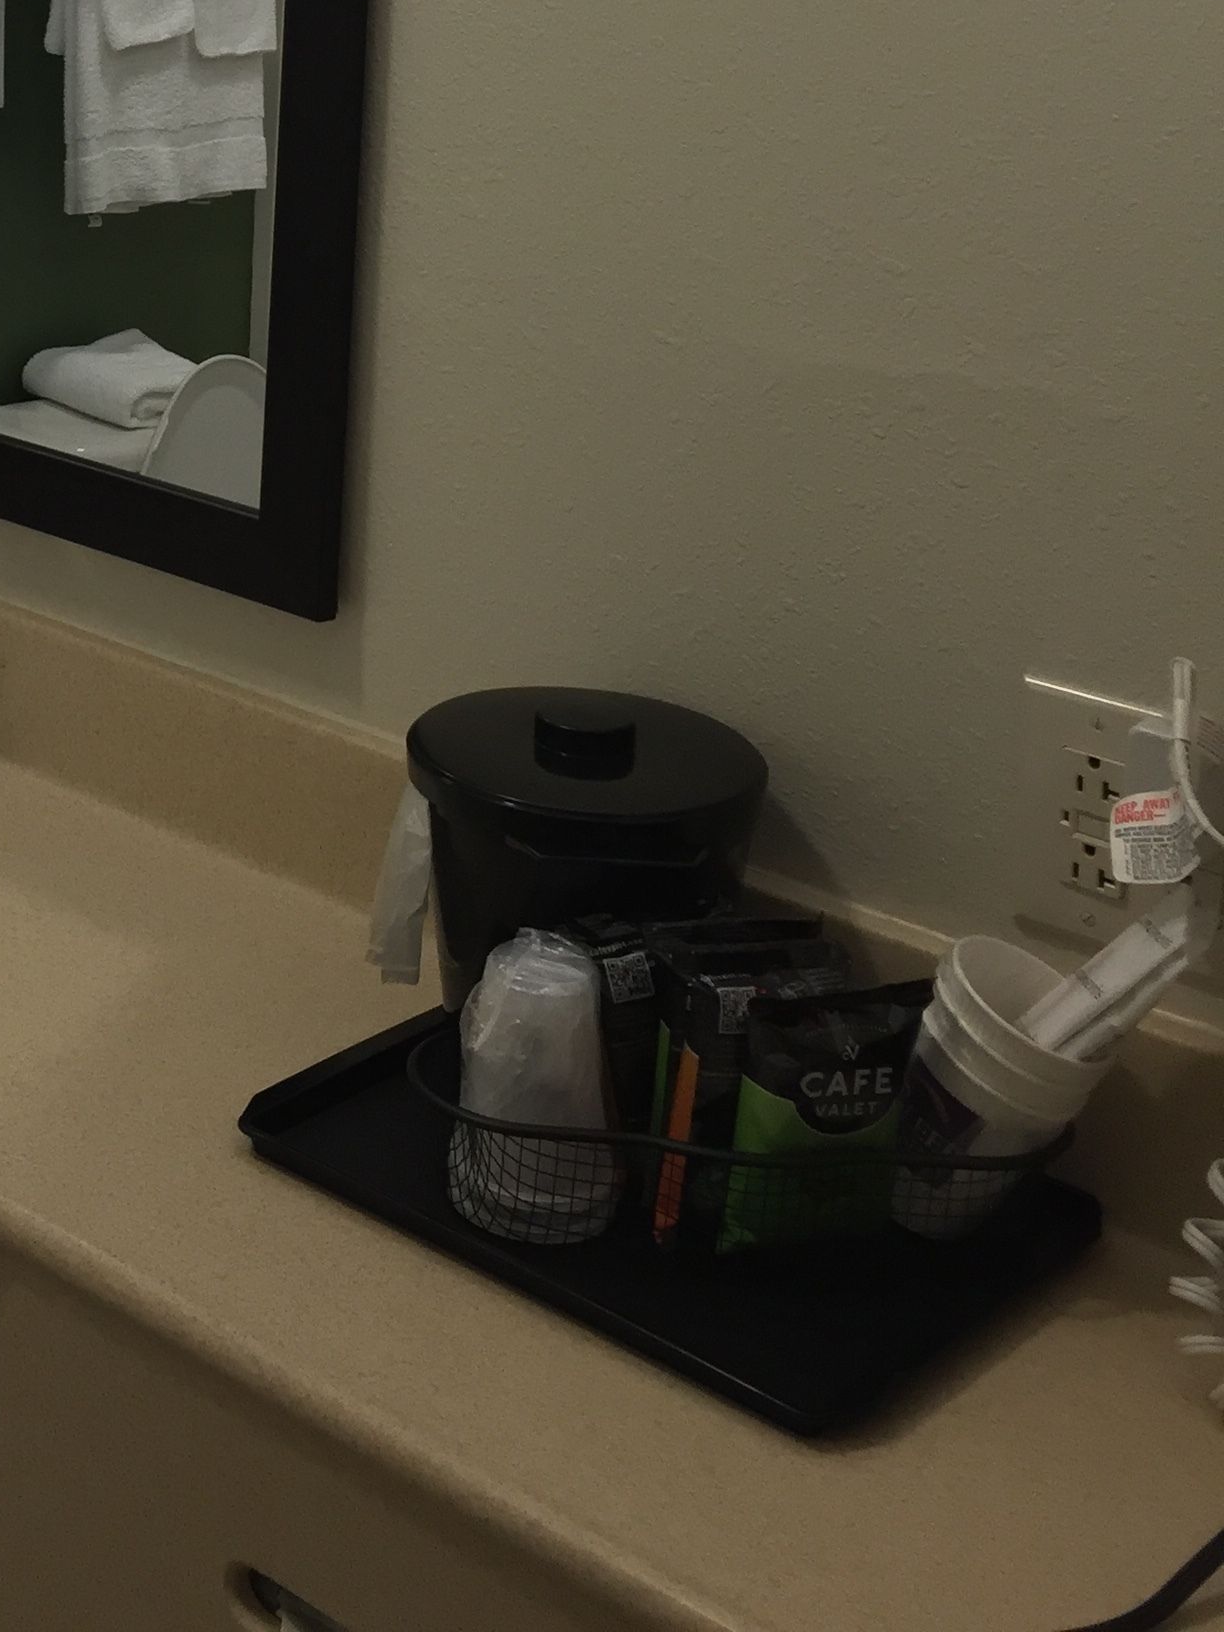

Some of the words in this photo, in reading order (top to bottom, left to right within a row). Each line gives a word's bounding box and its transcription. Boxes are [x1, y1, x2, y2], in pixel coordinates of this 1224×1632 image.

[1114, 800, 1138, 814] KEEP
[799, 1067, 893, 1099] CAFE
[815, 1101, 880, 1117] VALET
